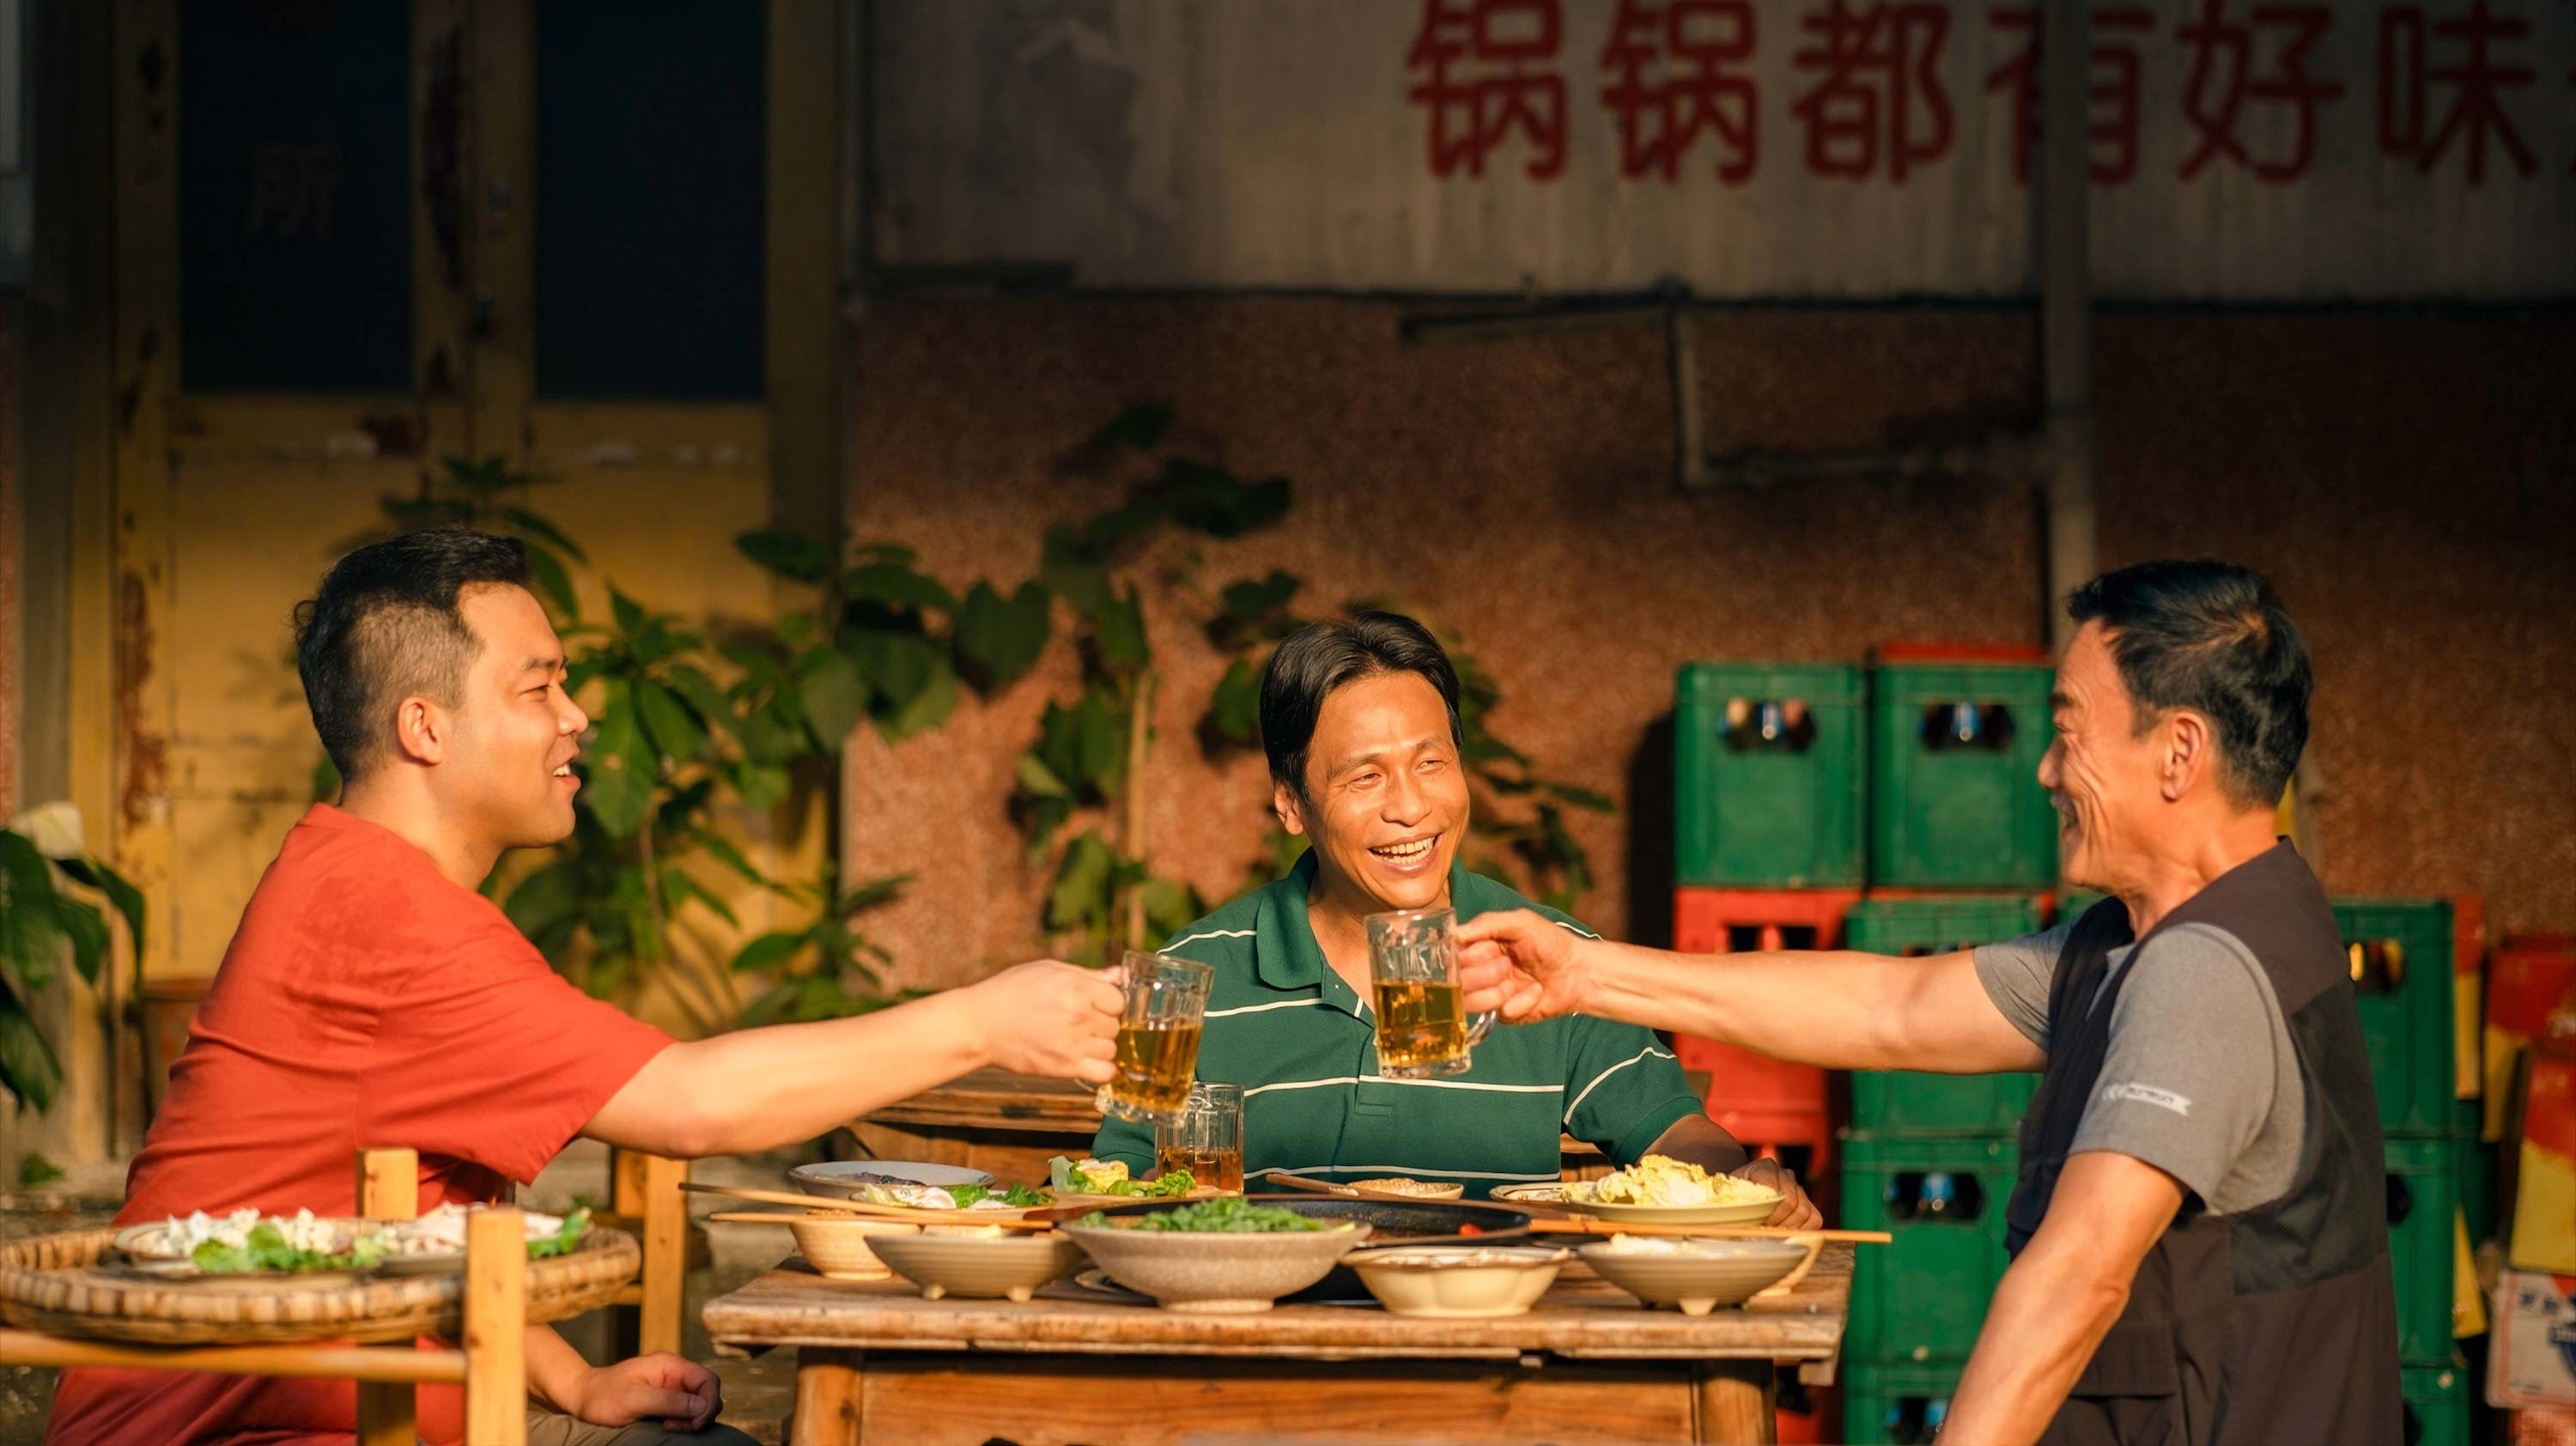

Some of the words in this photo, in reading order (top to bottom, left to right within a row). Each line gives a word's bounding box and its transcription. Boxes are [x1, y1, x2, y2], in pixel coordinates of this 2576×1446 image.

[1406, 0, 2576, 186] 锅锅都有好味
